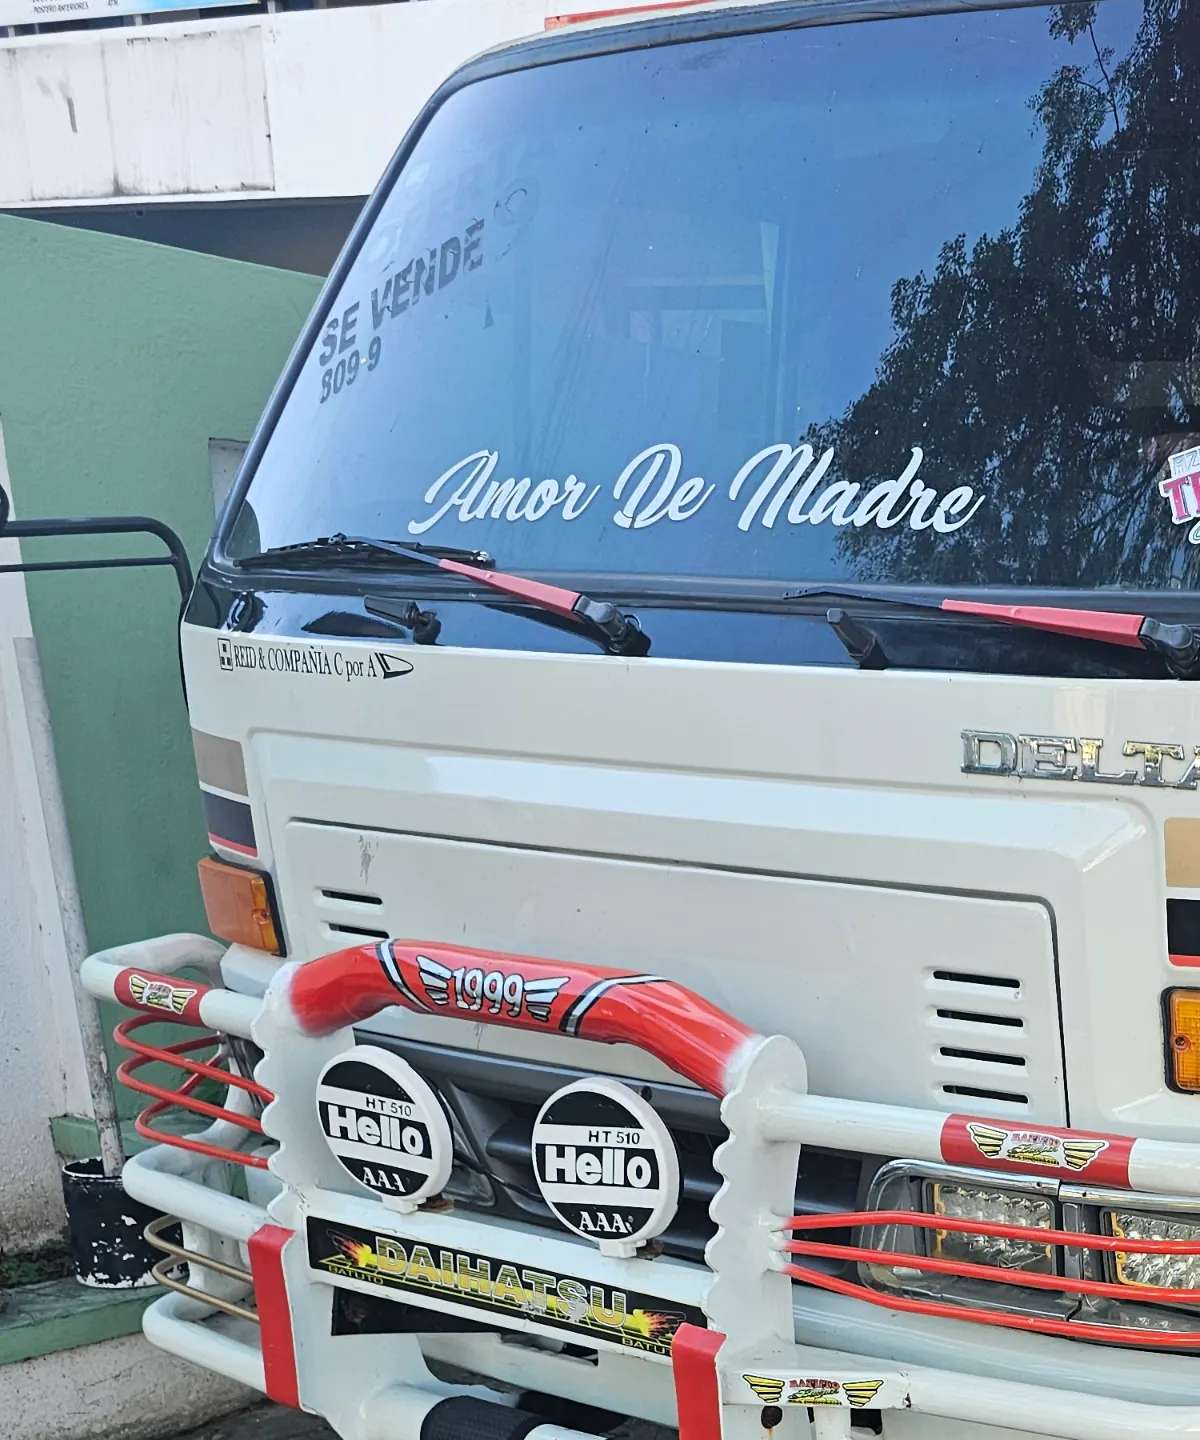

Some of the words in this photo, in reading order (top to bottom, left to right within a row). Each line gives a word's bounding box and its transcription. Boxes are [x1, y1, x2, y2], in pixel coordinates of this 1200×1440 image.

[319, 302, 360, 366] SE
[370, 218, 485, 329] VENDE
[408, 449, 601, 534] Amor
[612, 443, 715, 529] De
[728, 443, 986, 534] Madre
[234, 645, 257, 668] REID
[258, 647, 267, 670] &
[333, 652, 343, 676] C
[346, 659, 364, 682] por
[367, 655, 378, 677] A
[452, 966, 525, 1026] 1999
[327, 1104, 424, 1156] Hello
[391, 1103, 412, 1117] 510
[616, 1131, 640, 1145] 510
[545, 1145, 652, 1188] Hello
[373, 1236, 627, 1329] DAIHATSU
[622, 1336, 672, 1357] BATU
